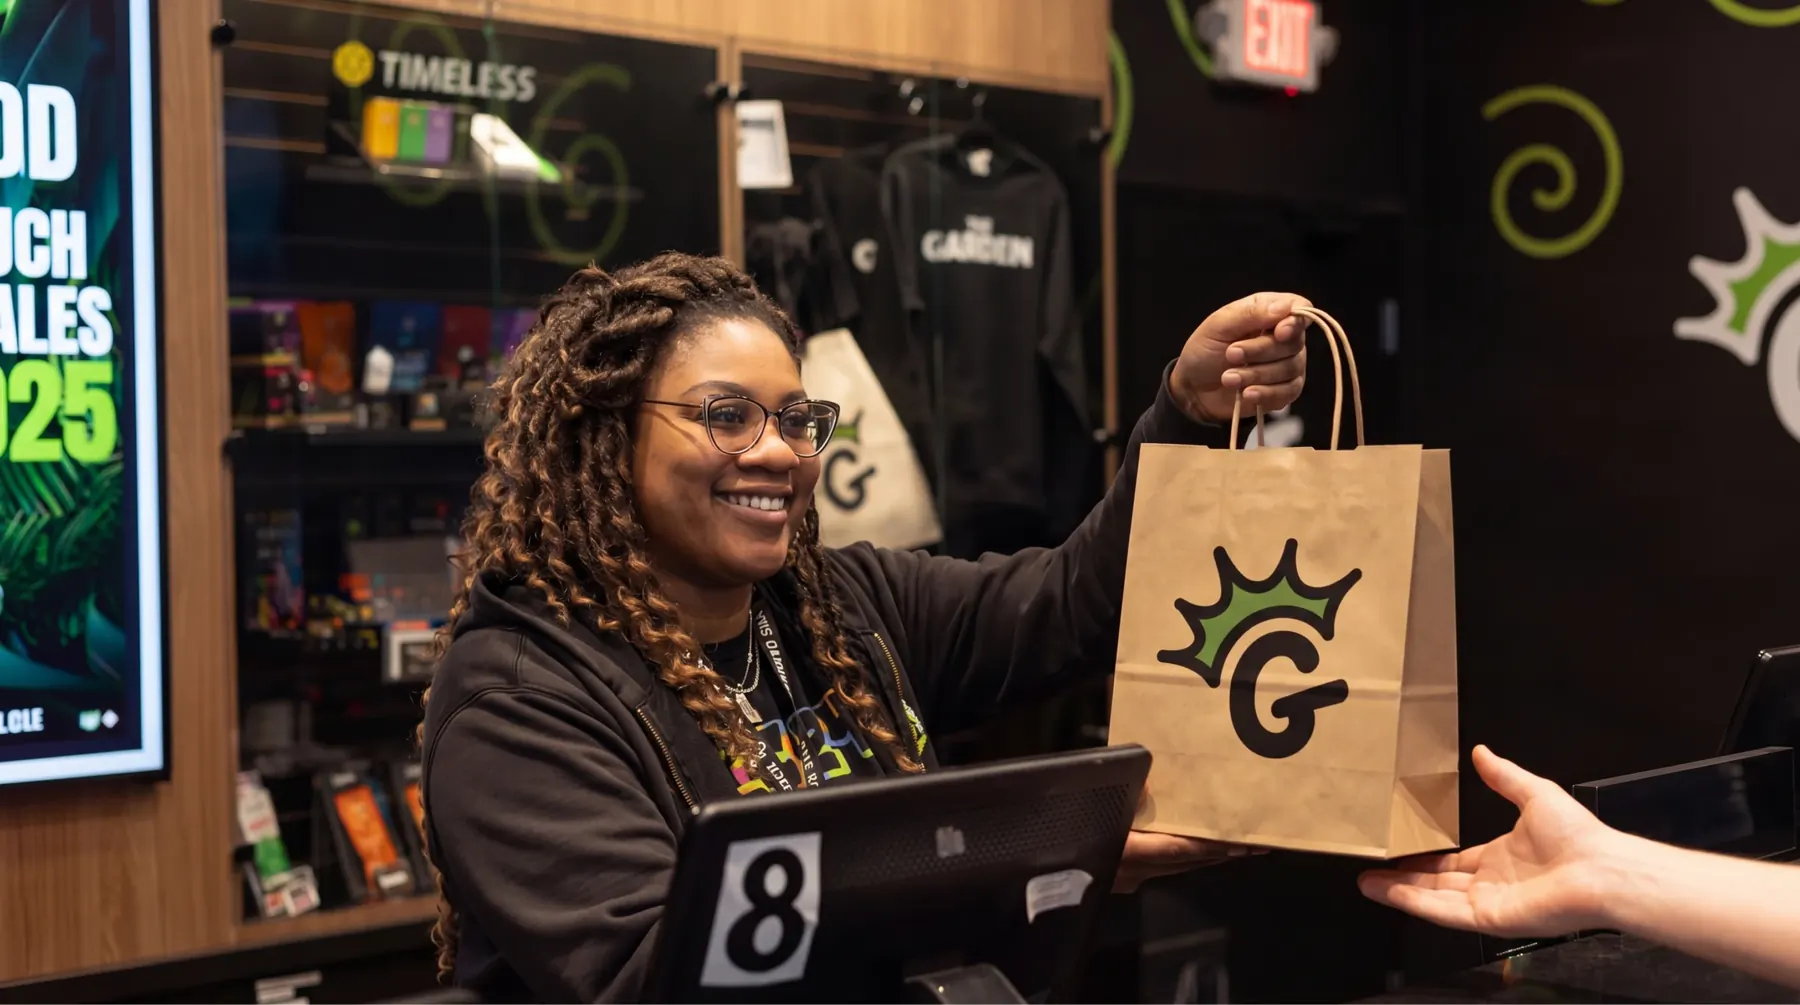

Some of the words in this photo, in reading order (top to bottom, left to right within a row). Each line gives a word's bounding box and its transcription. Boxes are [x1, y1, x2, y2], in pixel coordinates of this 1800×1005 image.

[379, 50, 537, 102] TIMELESS
[920, 228, 1034, 269] GARDEN
[1229, 630, 1349, 759] G
[725, 846, 804, 974] 8
